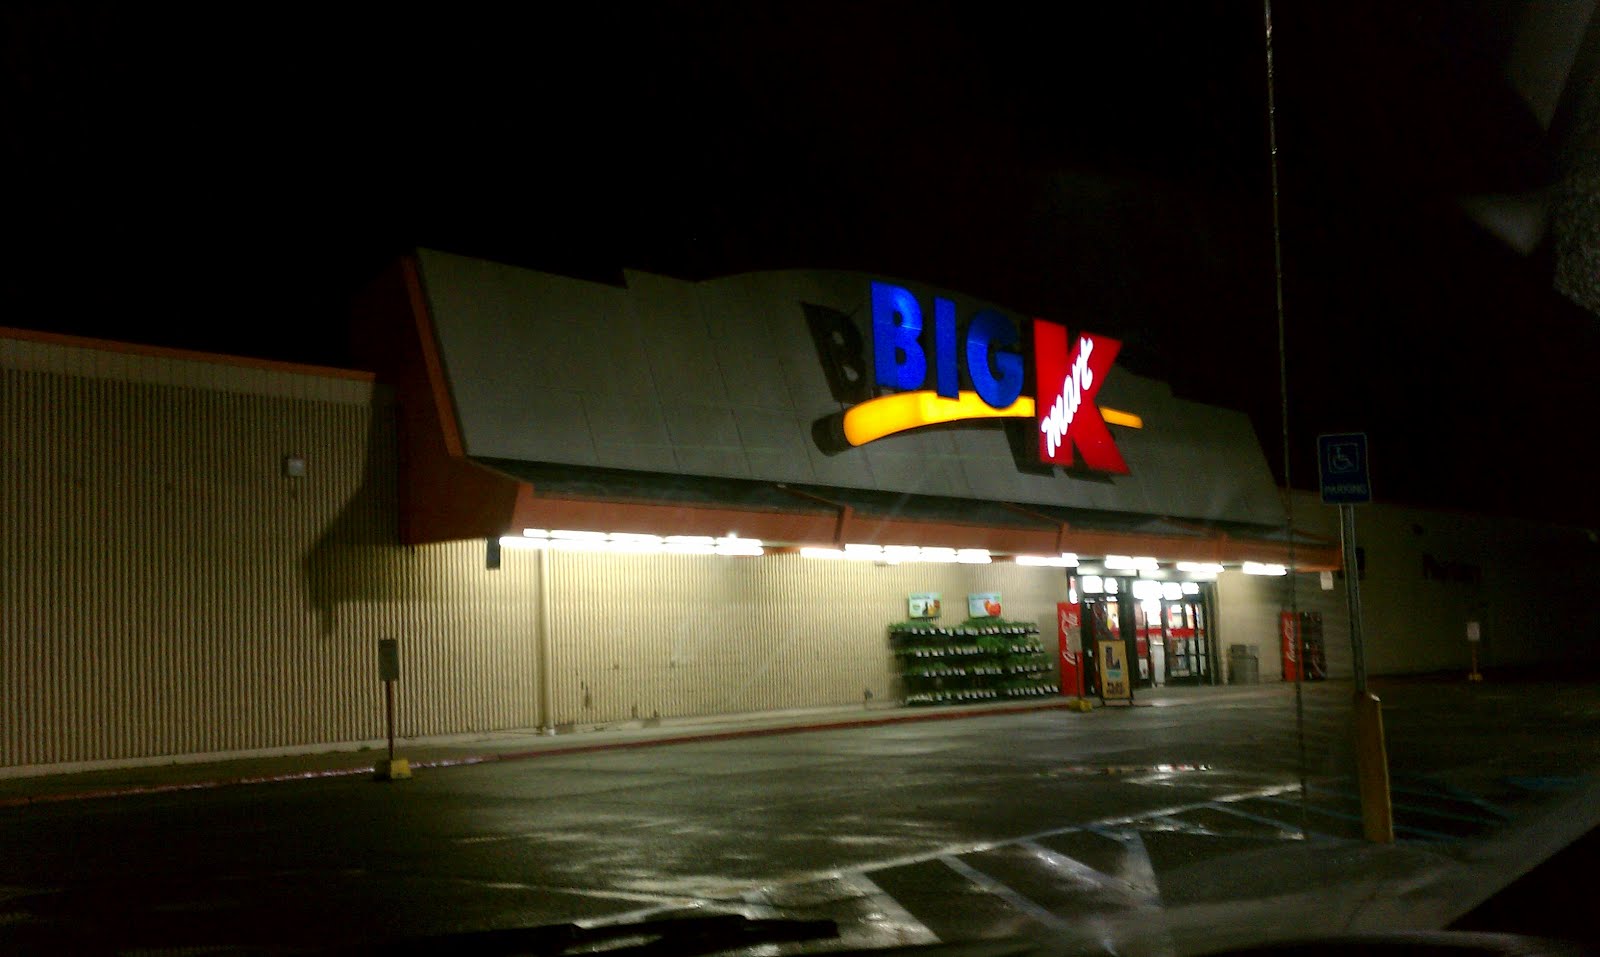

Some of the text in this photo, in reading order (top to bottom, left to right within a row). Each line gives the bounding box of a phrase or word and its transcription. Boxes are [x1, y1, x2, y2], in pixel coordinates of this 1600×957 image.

[870, 280, 1131, 475] BIG K
[1041, 336, 1094, 458] mart
[1325, 482, 1368, 495] PARKING
